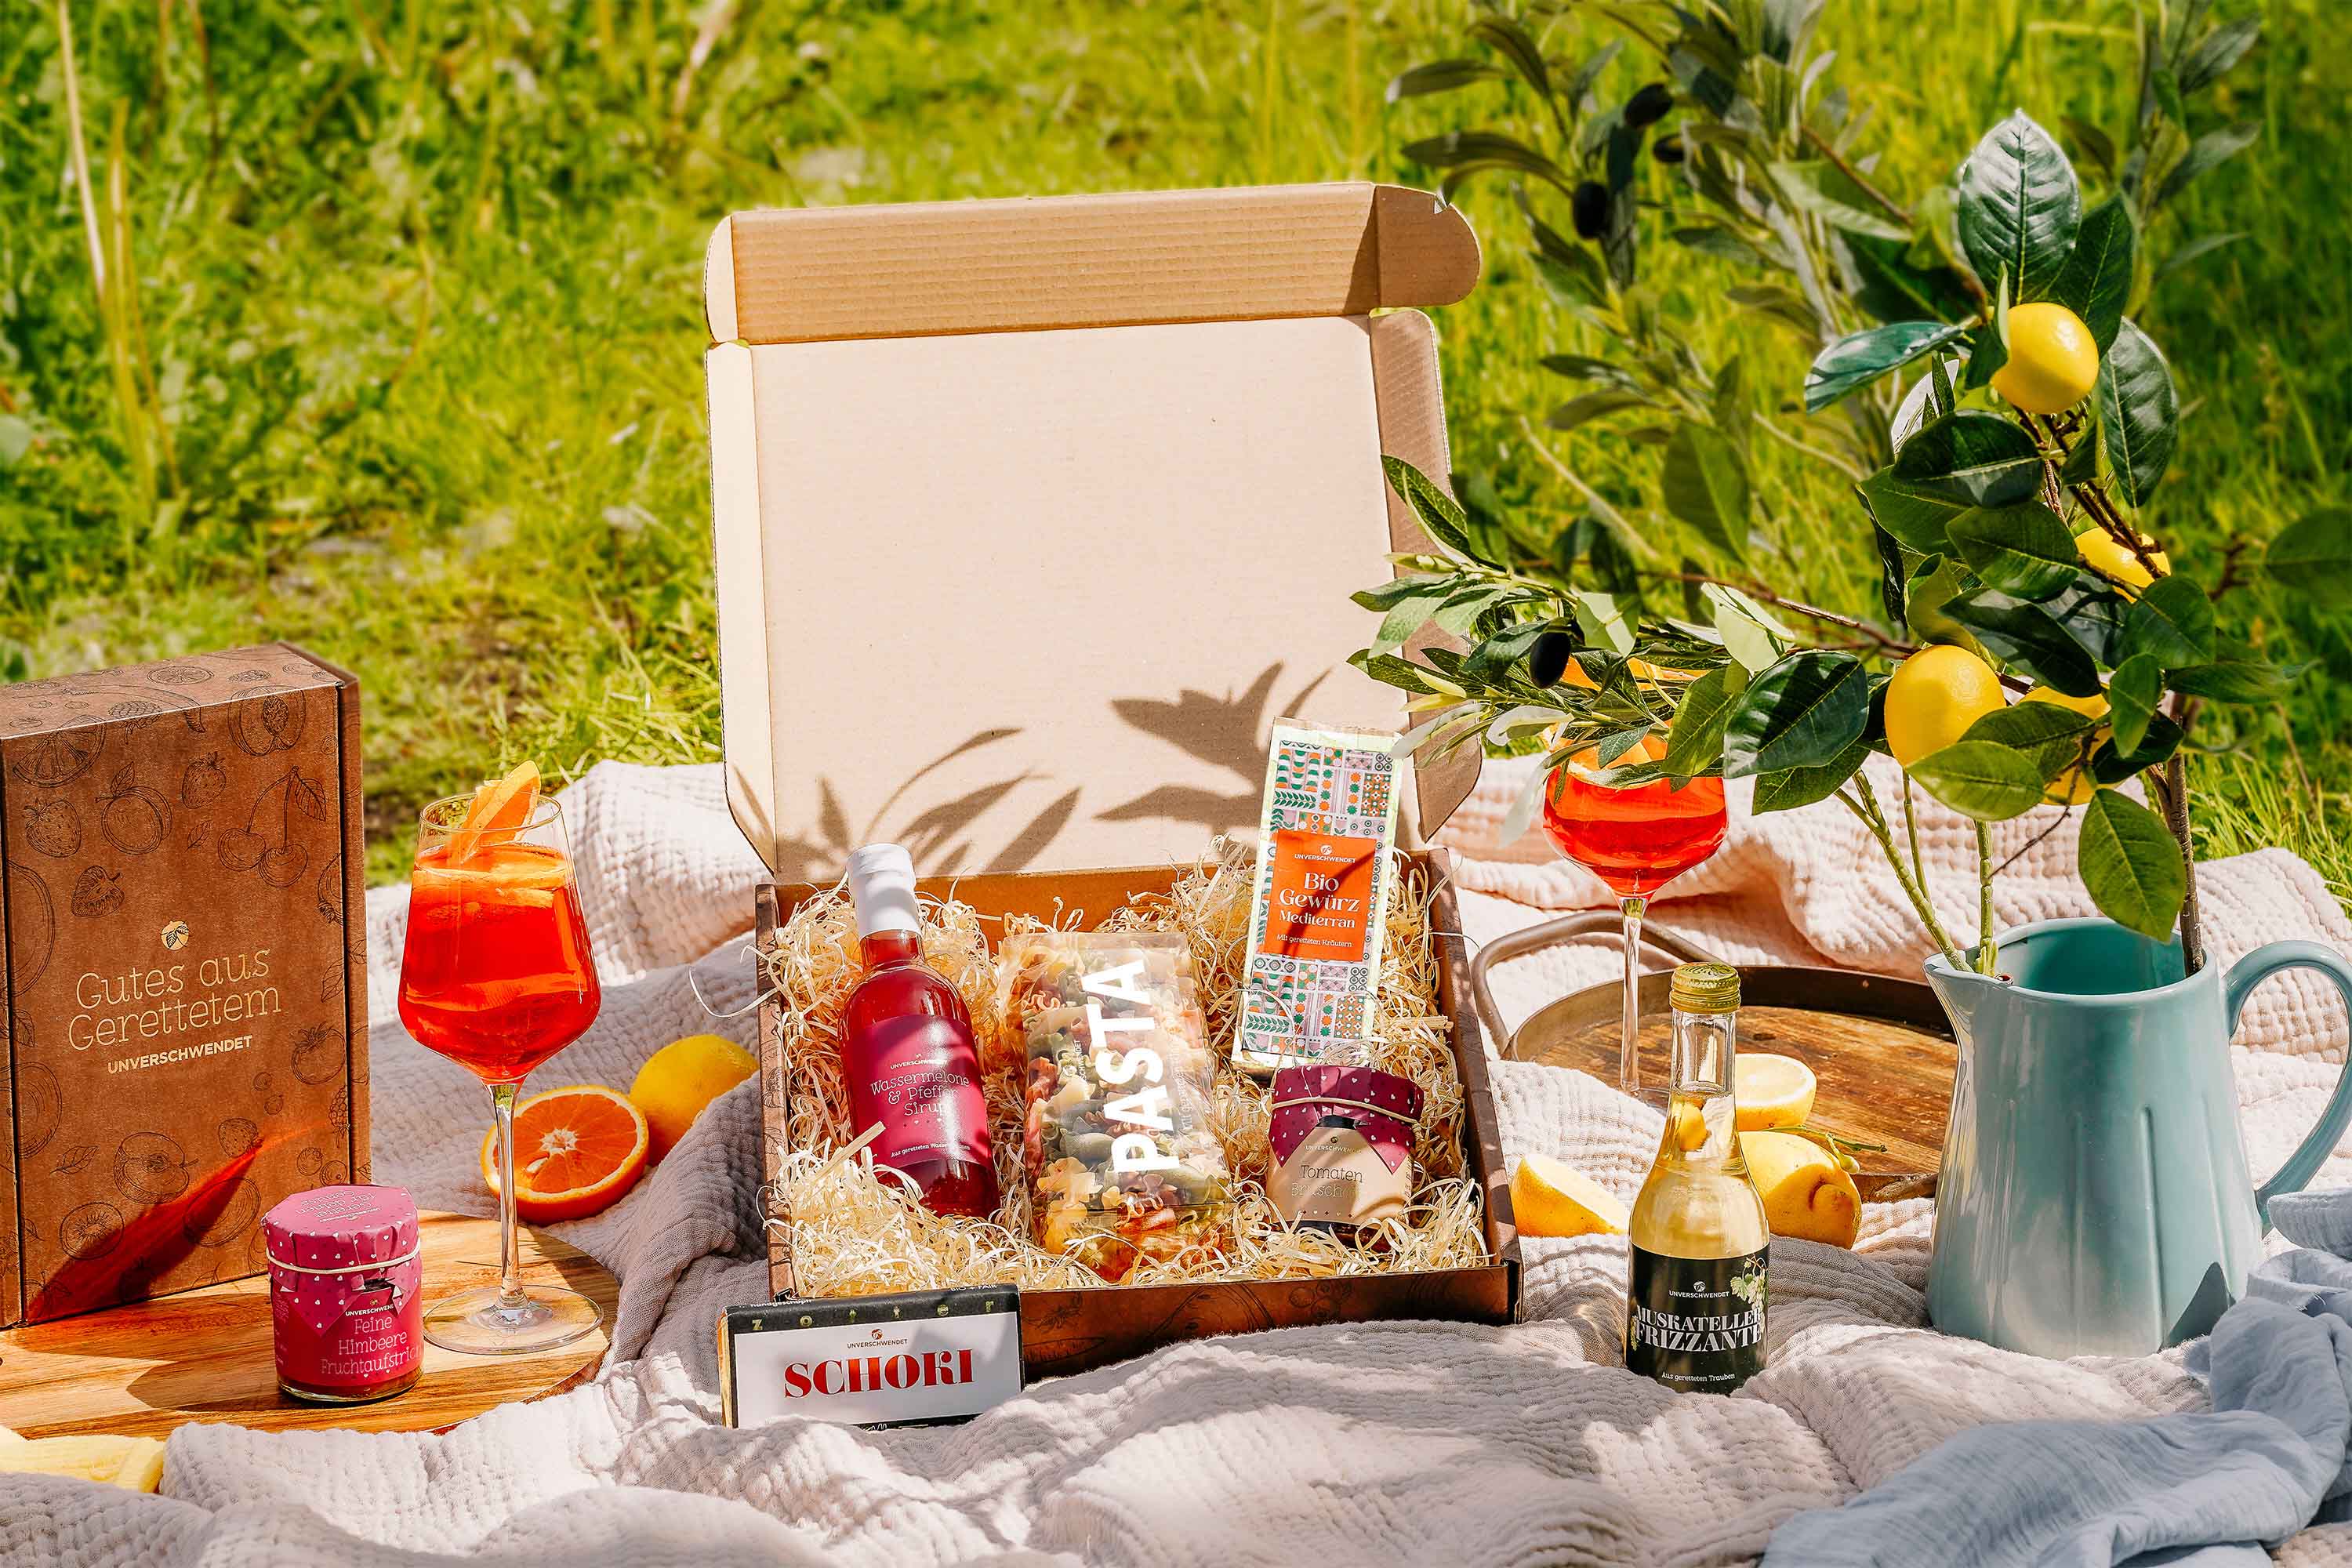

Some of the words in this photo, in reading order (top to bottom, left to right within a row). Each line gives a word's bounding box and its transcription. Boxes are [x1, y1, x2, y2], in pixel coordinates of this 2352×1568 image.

[1294, 854, 1356, 863] UNVERSCHWENDET
[1305, 872, 1339, 891] Bio
[1279, 888, 1360, 913] Gewürz
[1279, 910, 1356, 928] Mediterran
[1289, 936, 1321, 946] geretteten
[76, 964, 185, 1009] Gutes
[198, 948, 270, 988] aus
[67, 985, 281, 1051] Gerettetem
[107, 1034, 253, 1074] UNVERSCHWENDET
[1081, 959, 1180, 1174] PASTA
[871, 1069, 969, 1095] Wassermelone
[888, 1091, 901, 1105] &
[907, 1084, 959, 1101] Pfeffer
[1301, 1164, 1363, 1183] Tomaten
[1668, 1290, 1730, 1298] UNVERSCHWENDET
[354, 1316, 393, 1334] Feine
[1636, 1304, 1762, 1332] MUSKATELLER
[339, 1331, 408, 1355] Himbeere
[847, 1338, 909, 1349] UNVERSCHWENDET
[1635, 1320, 1762, 1352] FRIZZANTE
[784, 1348, 975, 1399] SCHOKI
[1662, 1371, 1674, 1380] Aus
[1708, 1373, 1736, 1381] Trauben
